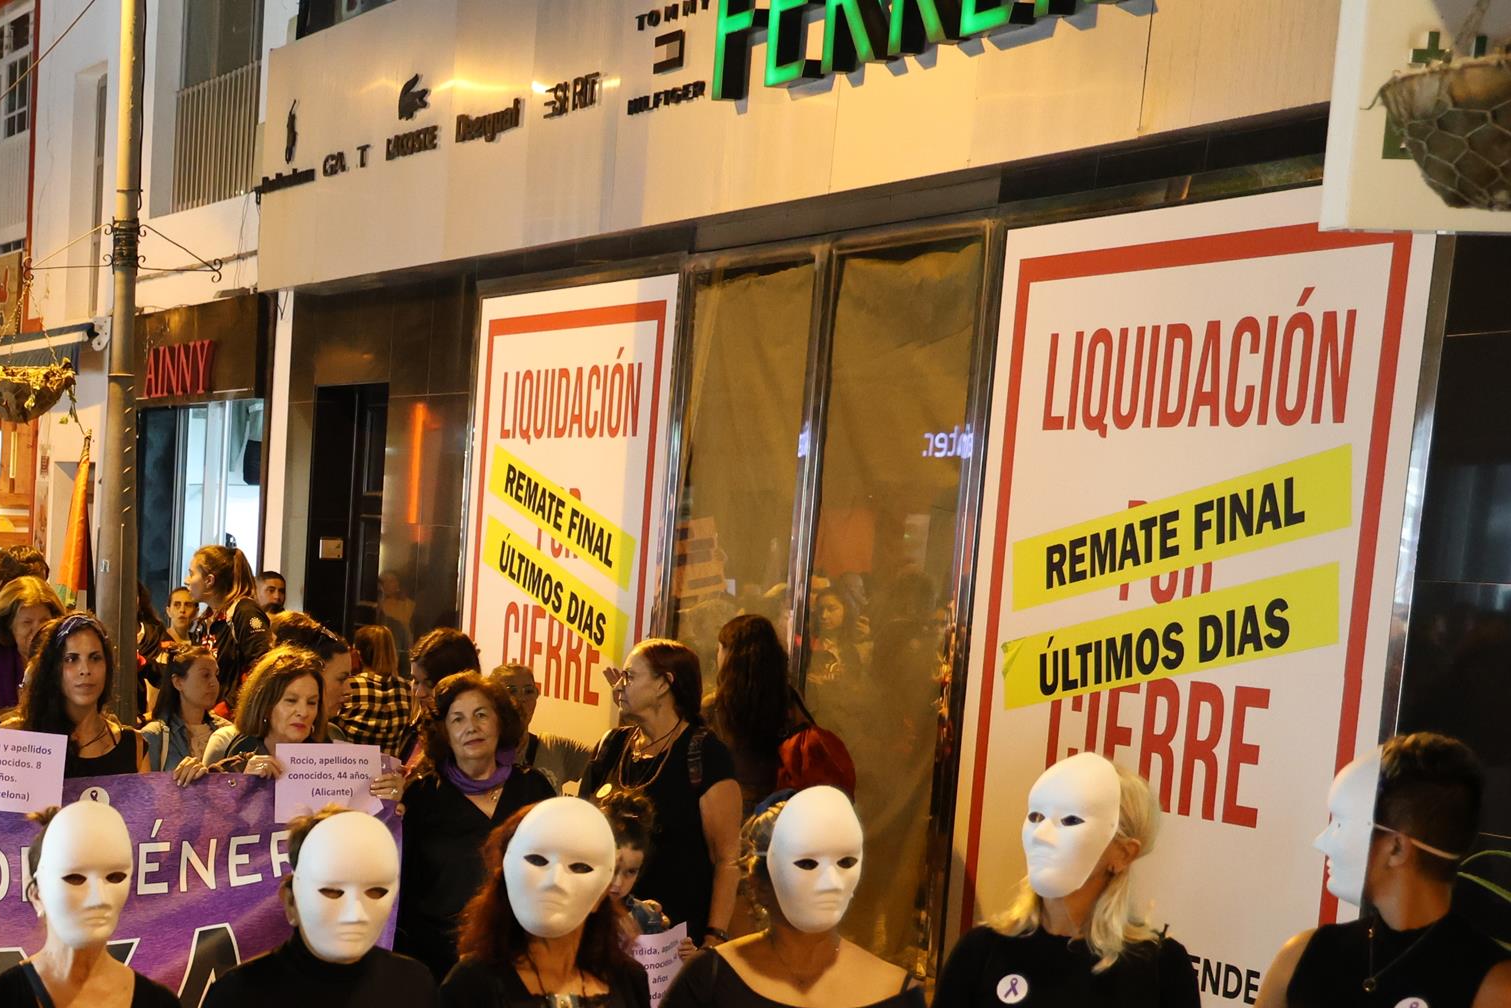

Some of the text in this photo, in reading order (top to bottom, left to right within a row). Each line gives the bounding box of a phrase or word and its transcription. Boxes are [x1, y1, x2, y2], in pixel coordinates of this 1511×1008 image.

[323, 144, 371, 177] GAT
[500, 346, 643, 445] LIQUIDACIÓN
[1042, 287, 1357, 438] LIQUIDACIÓN
[504, 462, 566, 533] REMATE
[567, 507, 613, 569] FINAL
[1045, 509, 1180, 590] REMATE
[1193, 477, 1306, 551] FINAL
[500, 533, 606, 647] ÚLTIMOS DIAS
[1039, 597, 1290, 696] ÚLTIMOS DIAS
[10, 743, 52, 756] apellidos
[35, 761, 42, 769] 8
[288, 772, 371, 781] conocidos, 44 años.
[319, 756, 357, 766] apellidos
[311, 787, 354, 798] (Alicante)
